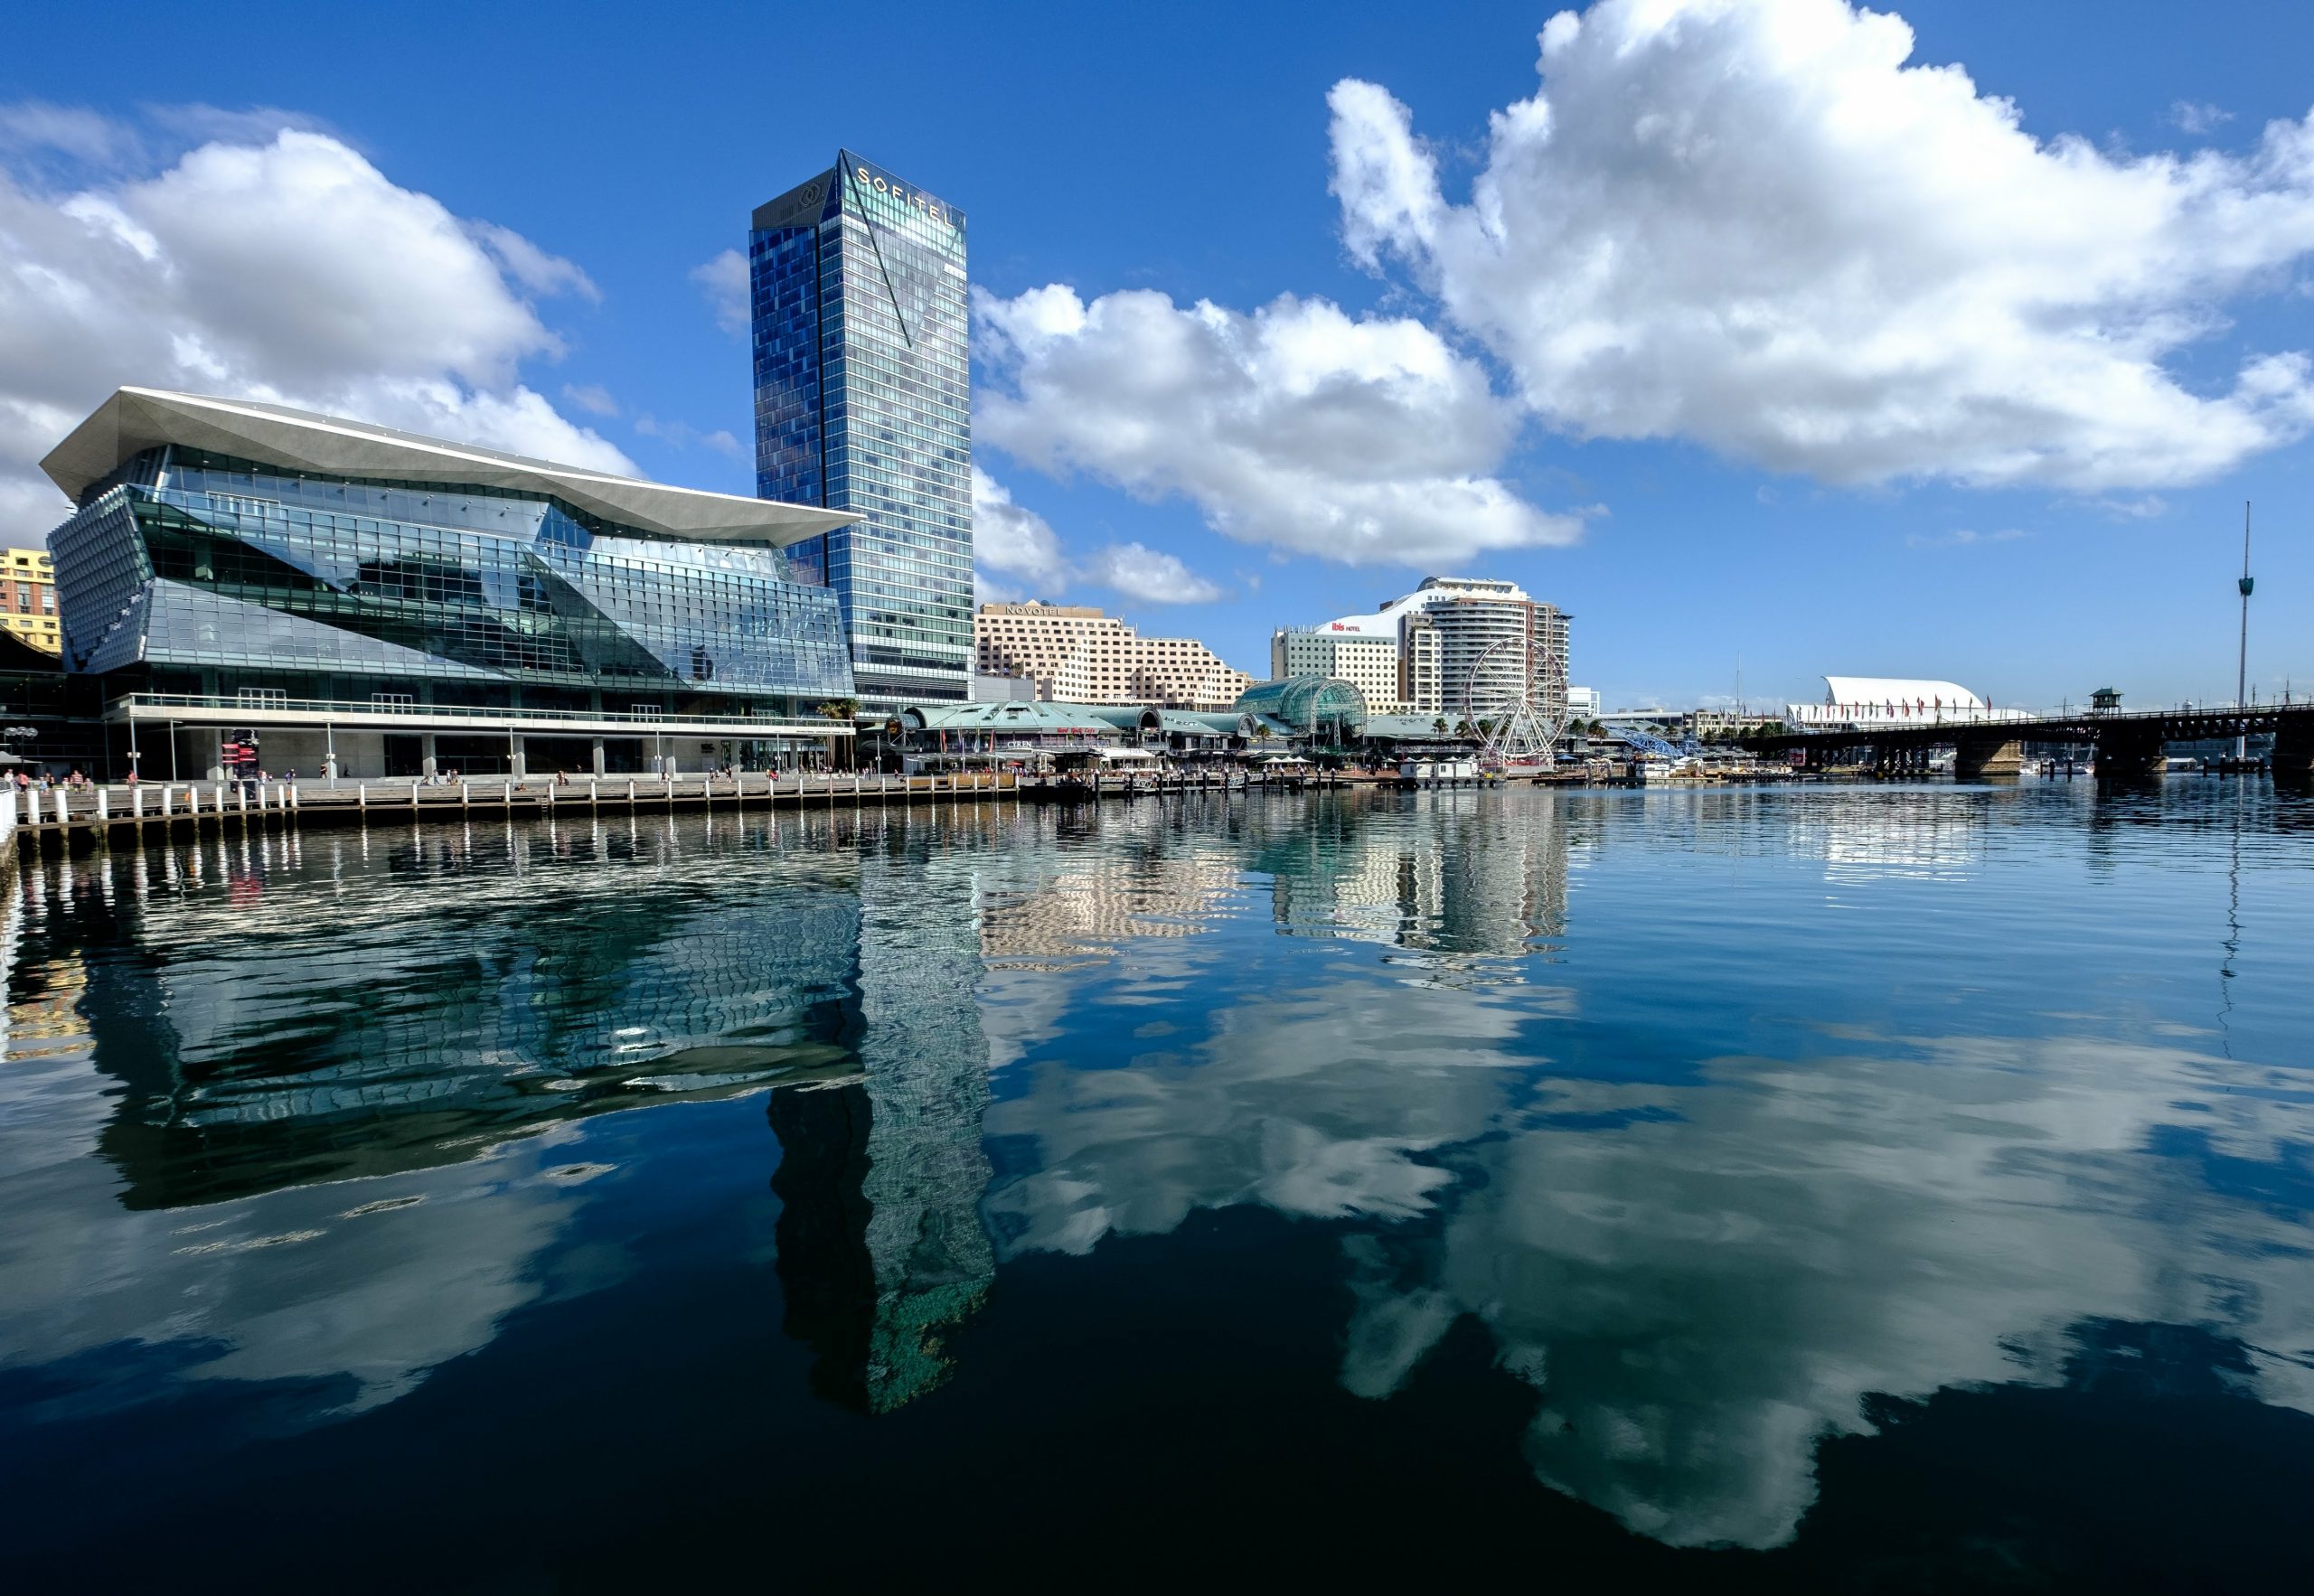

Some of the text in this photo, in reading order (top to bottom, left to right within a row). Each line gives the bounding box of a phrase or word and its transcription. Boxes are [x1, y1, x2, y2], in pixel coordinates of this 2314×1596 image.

[857, 167, 955, 228] SOFITEL
[1006, 606, 1063, 616] NOVOTEL
[1332, 623, 1344, 631] ibis
